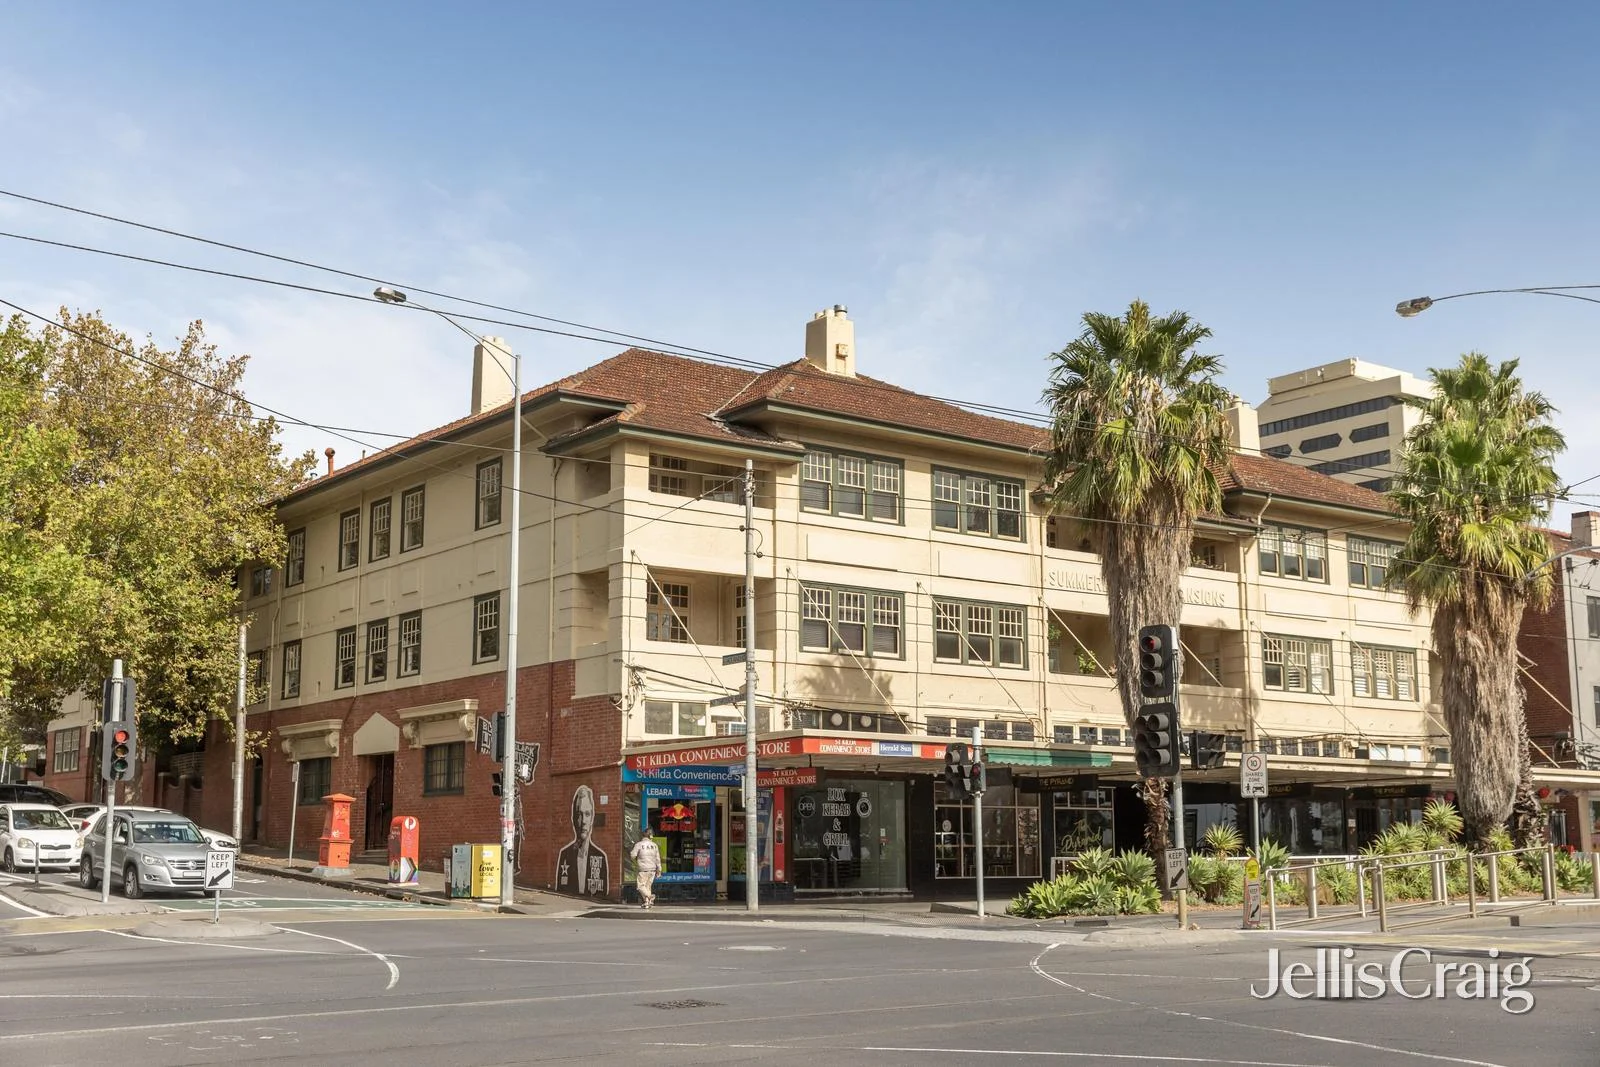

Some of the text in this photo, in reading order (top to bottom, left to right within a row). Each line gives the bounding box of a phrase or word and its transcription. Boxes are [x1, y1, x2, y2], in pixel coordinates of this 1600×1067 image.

[1049, 570, 1226, 608] SUMMERL NSIONS
[820, 745, 872, 754] CONVENIENCE STORE
[880, 744, 899, 752] Herald
[637, 756, 647, 768] ST
[649, 753, 677, 766] KILDA
[680, 744, 746, 763] CONVENIENC
[637, 769, 646, 779] St
[649, 769, 671, 779] Kilda
[673, 769, 733, 780] Convenience
[757, 776, 816, 786] CONVENIENCE STORE
[647, 788, 672, 796] LEBARA
[799, 803, 815, 811] OPEN
[822, 803, 851, 817] KEBAB
[833, 817, 841, 831] &
[823, 832, 850, 847] GRILL
[211, 853, 230, 861] KEEP
[1168, 852, 1182, 860] KEEP
